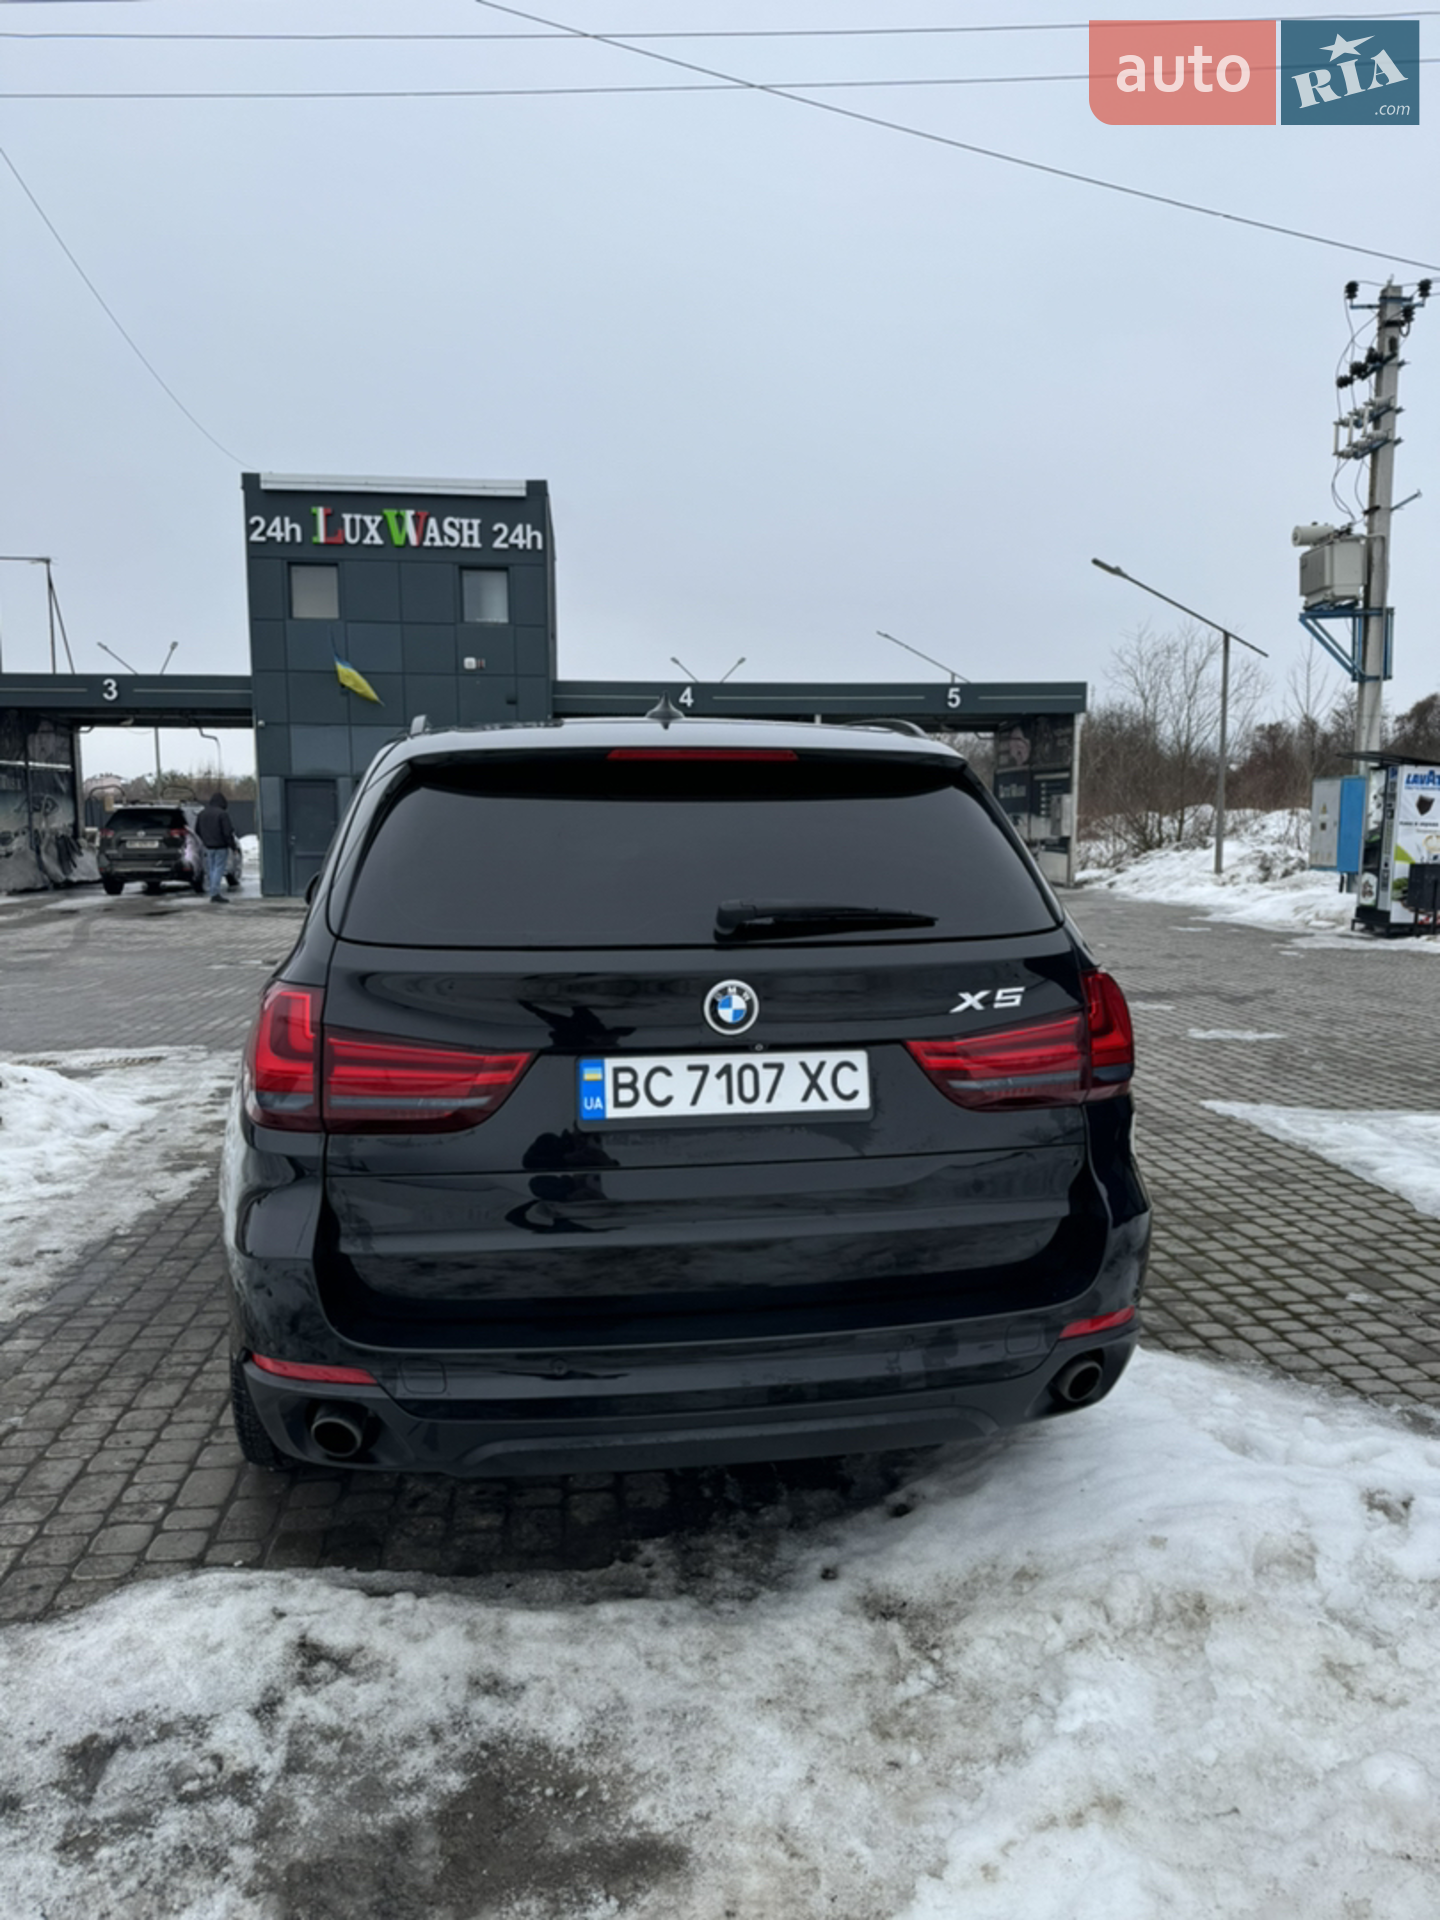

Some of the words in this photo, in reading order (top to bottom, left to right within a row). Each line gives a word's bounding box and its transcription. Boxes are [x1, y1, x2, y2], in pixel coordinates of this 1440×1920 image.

[249, 515, 302, 543] 24h
[491, 522, 543, 550] 24h
[102, 678, 119, 701] 3
[679, 686, 695, 708] 4
[947, 687, 961, 709] 5
[949, 986, 1026, 1014] X5
[612, 1065, 674, 1109] BC
[686, 1062, 785, 1106] 7107
[799, 1060, 860, 1103] XC
[584, 1096, 603, 1111] UA
